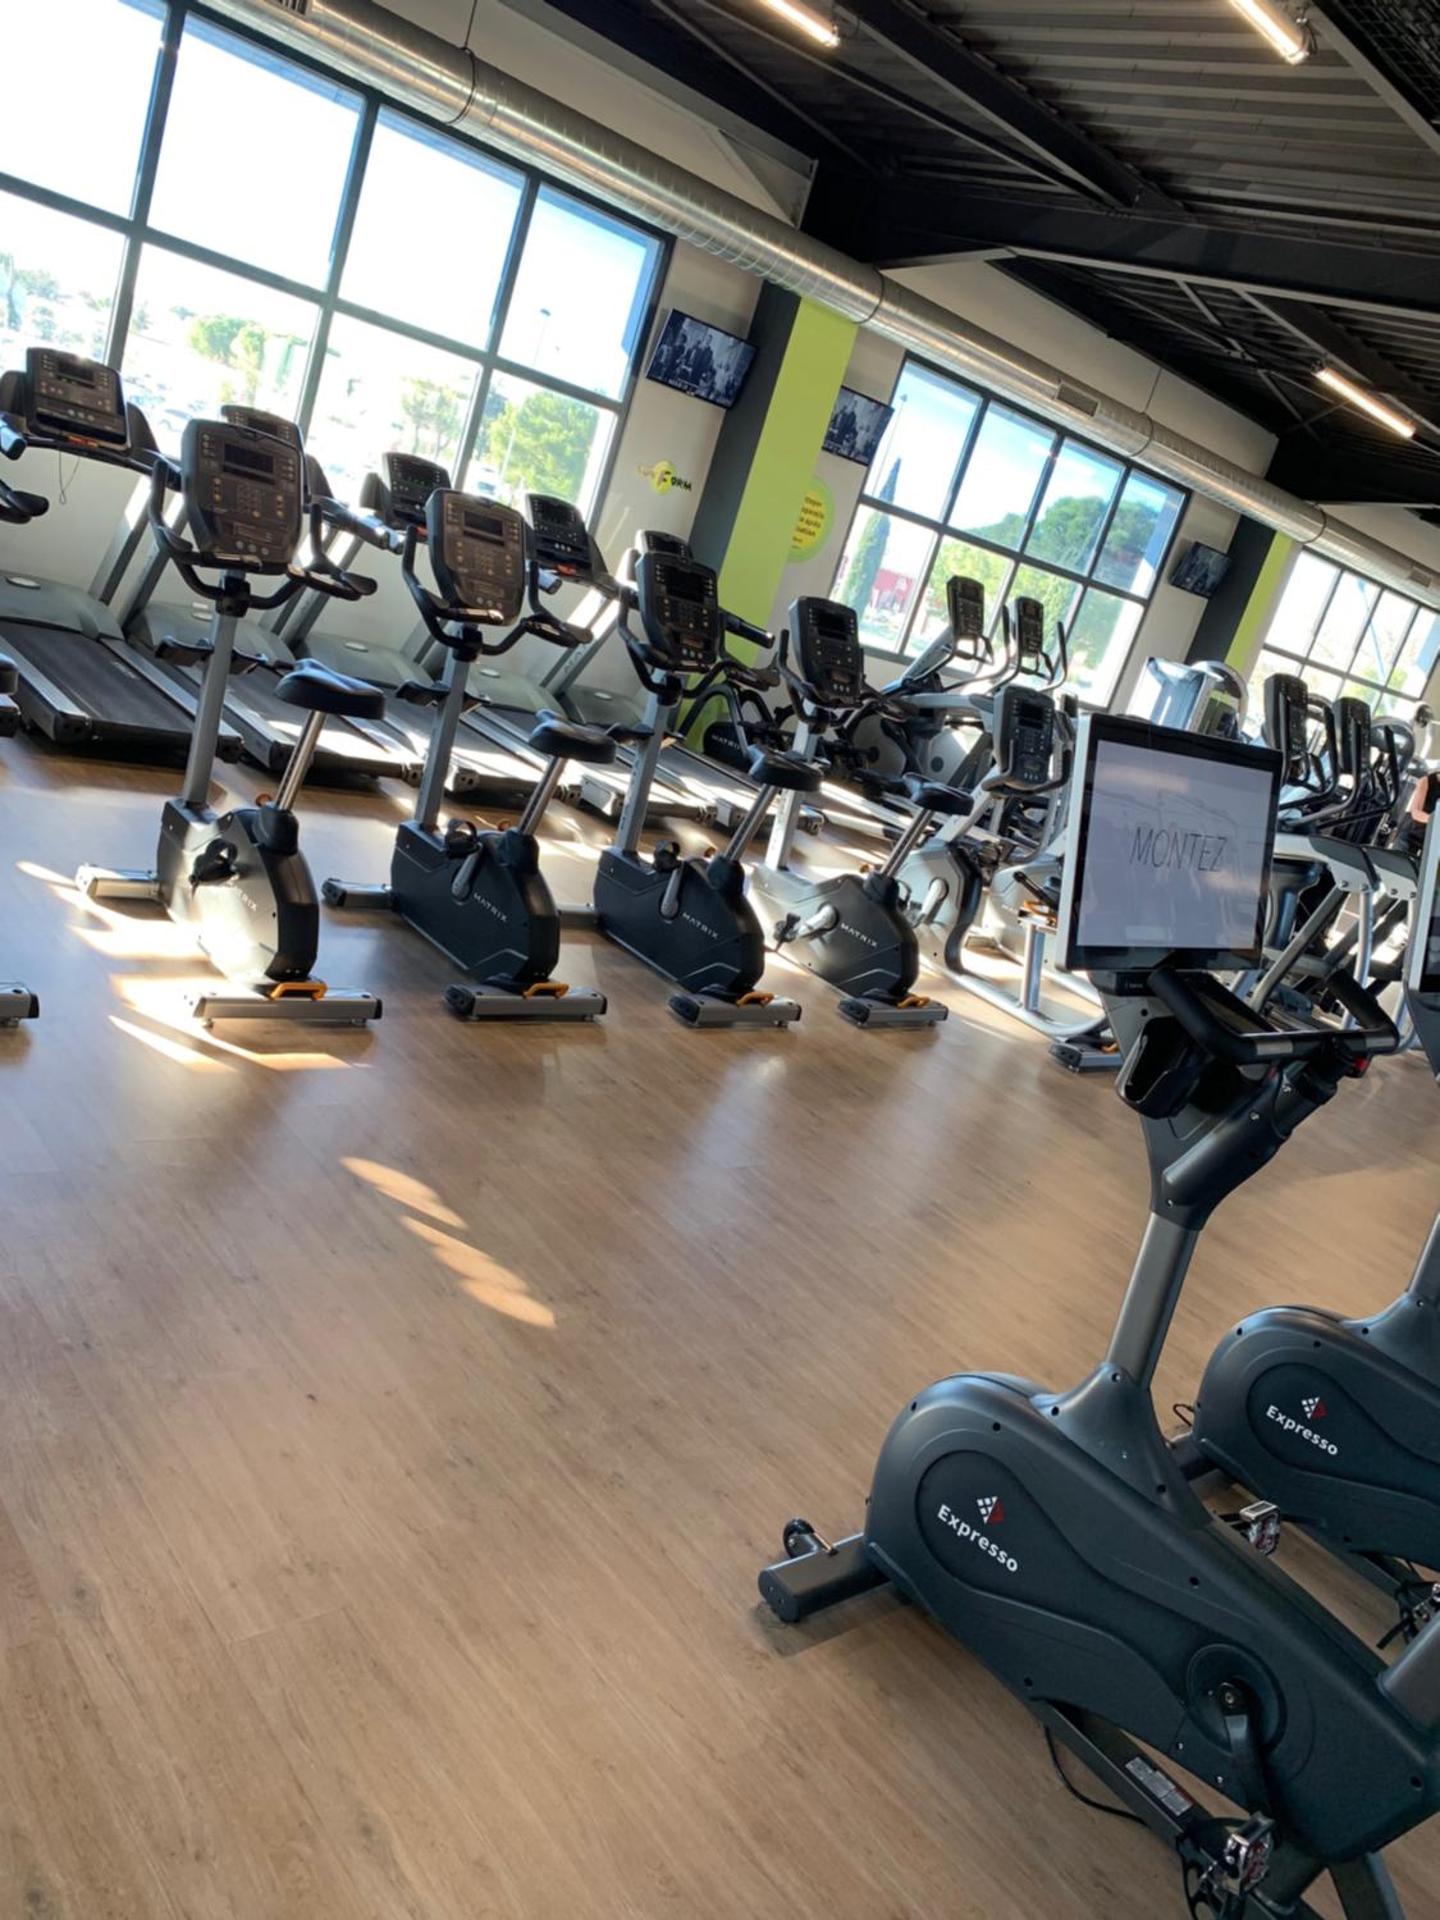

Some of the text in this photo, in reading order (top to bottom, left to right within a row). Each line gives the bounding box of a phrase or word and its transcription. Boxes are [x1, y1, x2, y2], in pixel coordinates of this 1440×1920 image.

[1129, 826, 1228, 873] MONTEZ
[473, 892, 508, 923] MATRIX
[681, 911, 719, 940] MATRIX
[840, 922, 879, 948] MATRIX
[1265, 1404, 1339, 1456] Expresso
[936, 1503, 1020, 1573] Expresso
